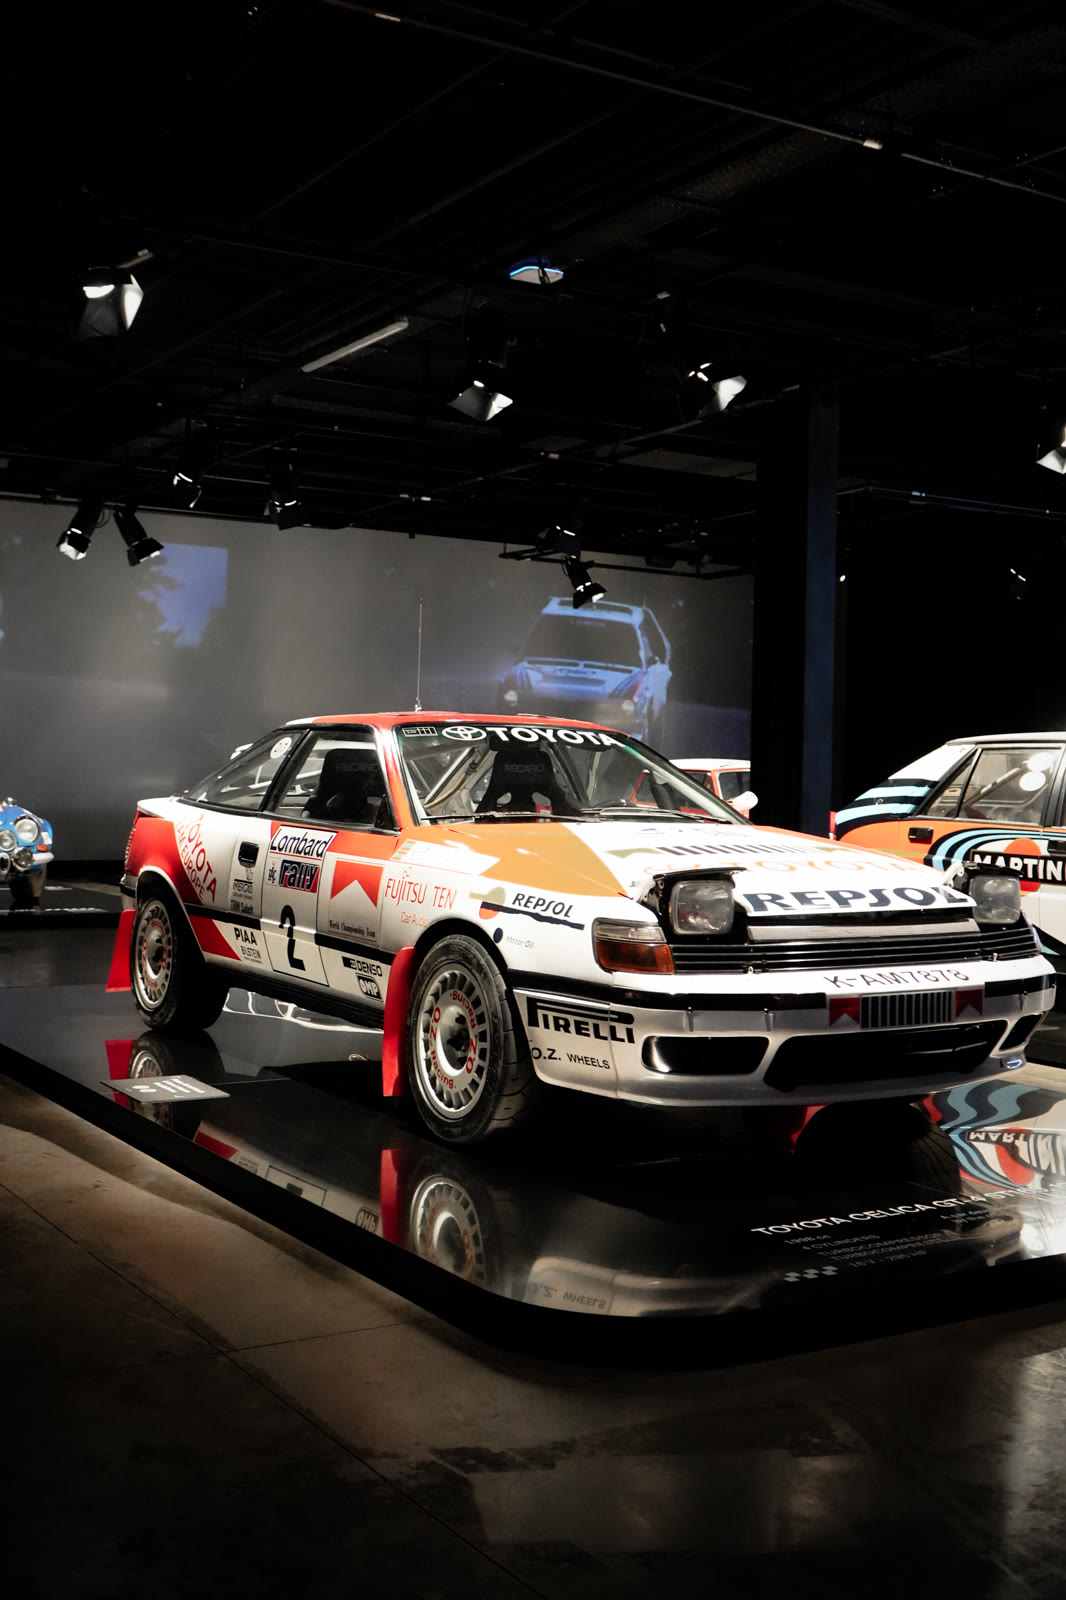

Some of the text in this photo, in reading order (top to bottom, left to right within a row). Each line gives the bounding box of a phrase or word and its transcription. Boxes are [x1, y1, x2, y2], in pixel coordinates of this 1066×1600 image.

[486, 727, 625, 748] TOYOTA
[504, 763, 545, 774] RECARO
[271, 828, 332, 858] Lombard
[187, 813, 217, 903] TOYOTA
[279, 860, 320, 892] rally
[384, 878, 457, 909] FUJITSU TEN
[511, 892, 574, 918] REPSOL
[742, 886, 968, 912] REPSOL
[401, 911, 412, 924] Car
[233, 927, 258, 946] PIAA
[279, 905, 306, 971] 2
[357, 961, 383, 977] DENSO
[824, 968, 971, 989] K-AM7878
[359, 976, 379, 997] OMP
[526, 997, 635, 1044] PIRELLI
[532, 1047, 611, 1070] O.Z. WHEELS
[750, 1216, 853, 1236] TOYOTA
[848, 1203, 937, 1221] CELICA
